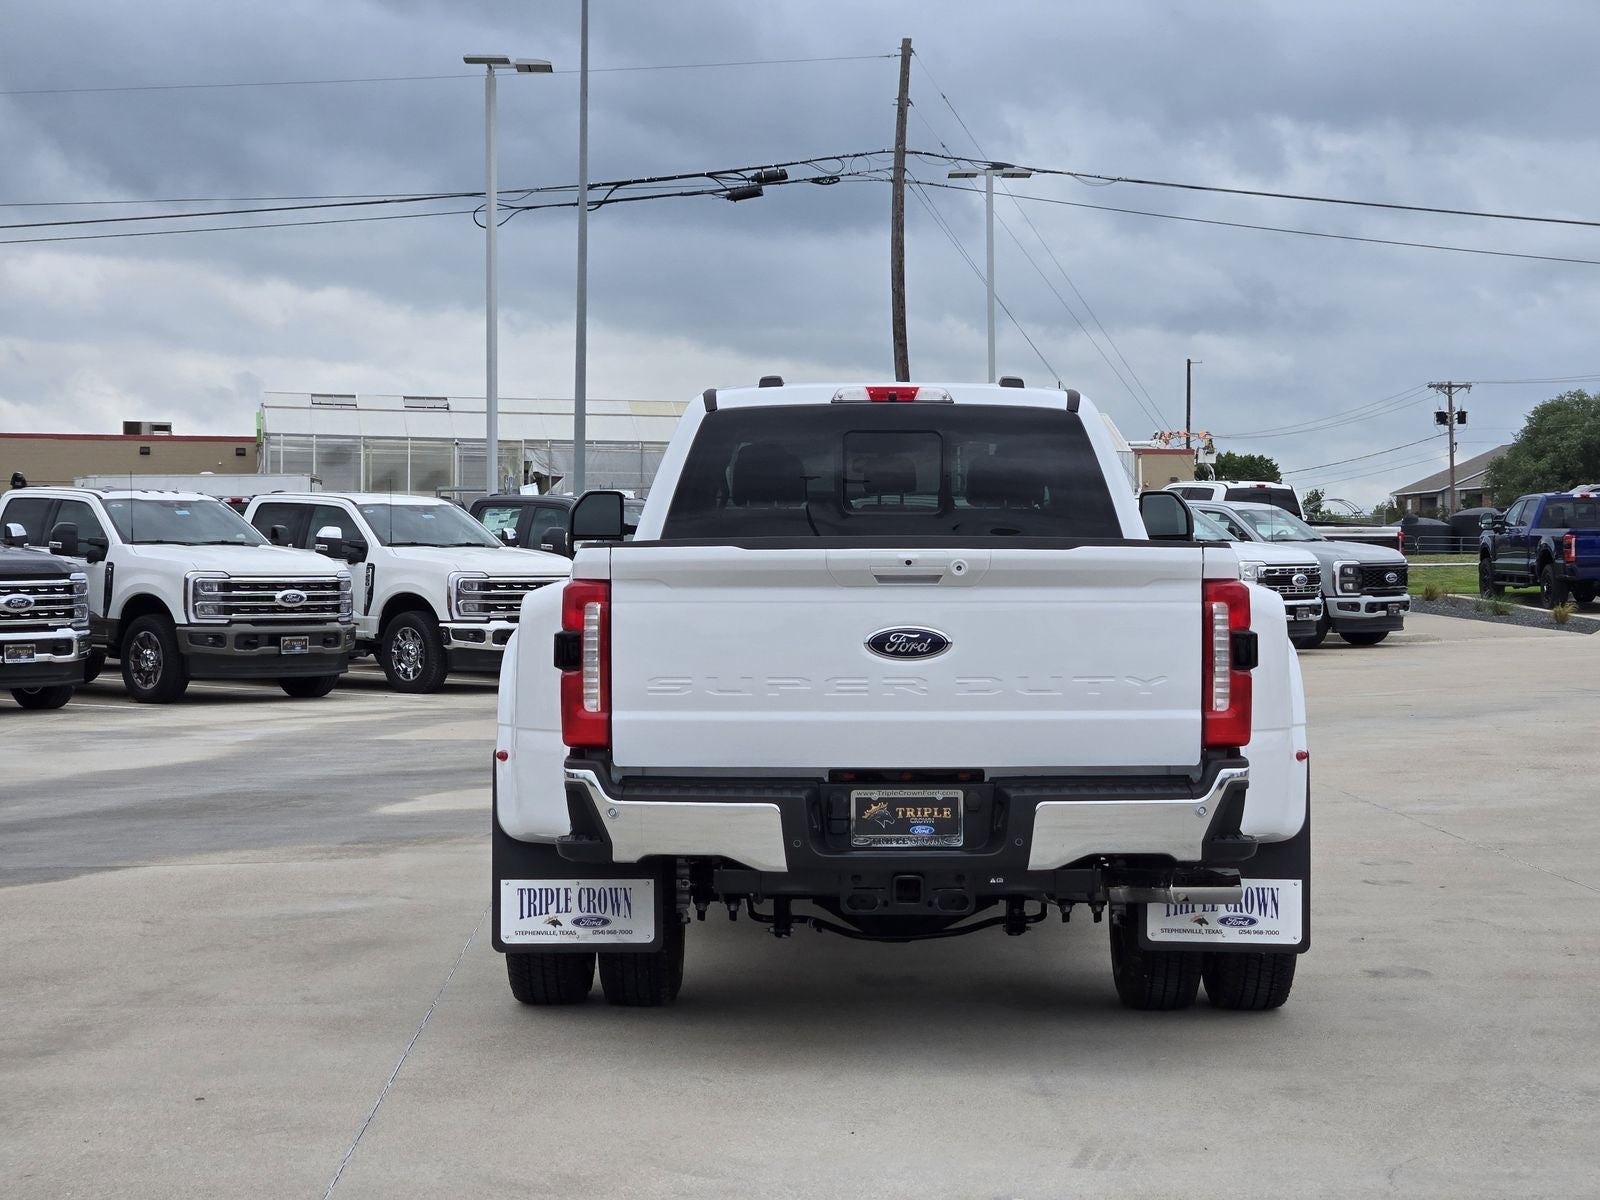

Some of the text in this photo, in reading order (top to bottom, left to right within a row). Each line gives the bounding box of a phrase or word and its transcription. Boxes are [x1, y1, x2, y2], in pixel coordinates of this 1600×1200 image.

[885, 632, 931, 652] Ford
[646, 675, 1168, 696] SUPER DUTY
[895, 807, 952, 818] TRIPLE
[516, 886, 632, 920] TRIPLE CROWN
[579, 918, 603, 926] Ford
[1225, 917, 1251, 927] Ford
